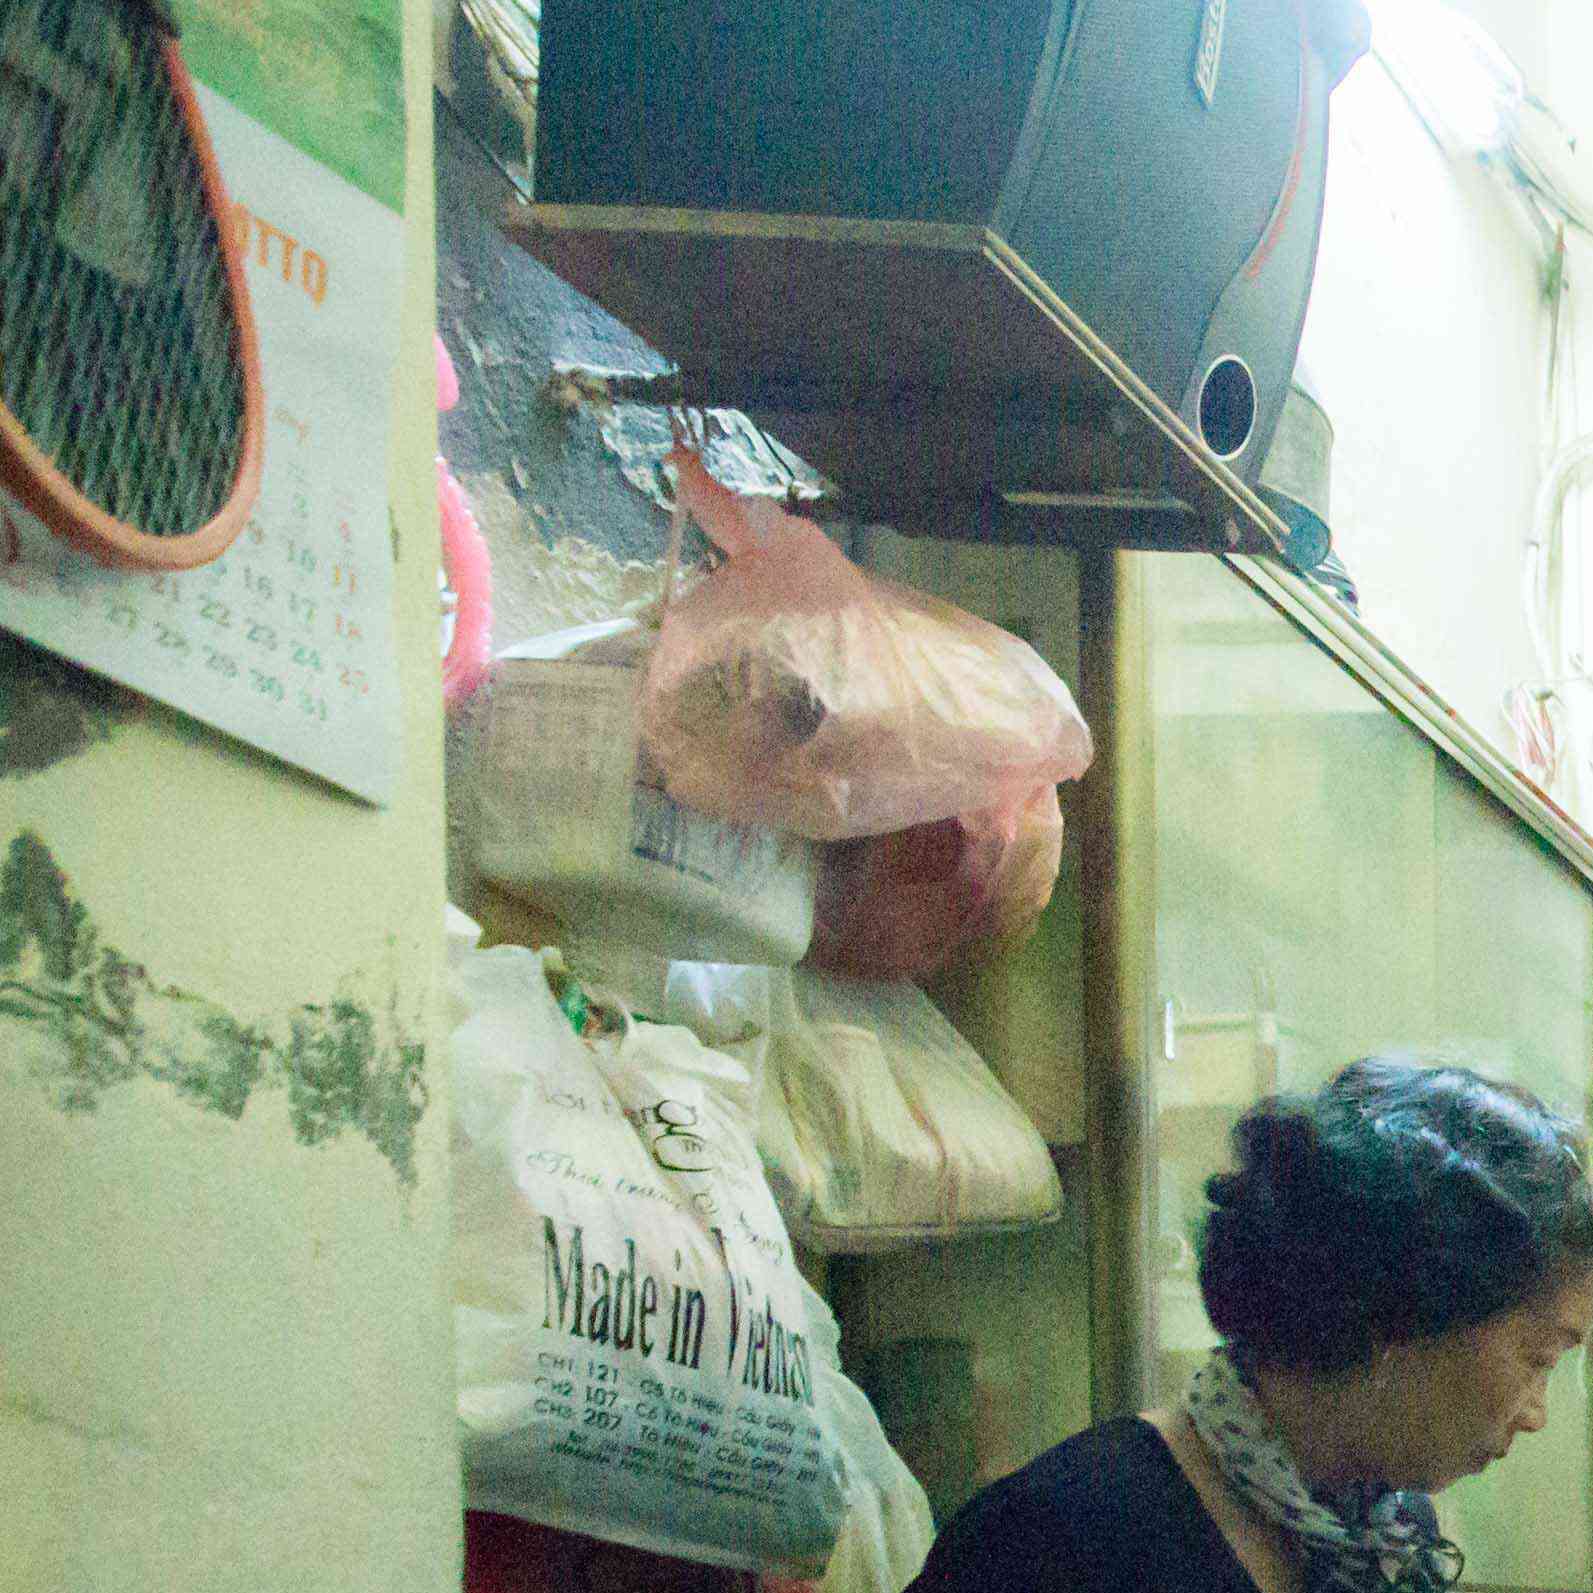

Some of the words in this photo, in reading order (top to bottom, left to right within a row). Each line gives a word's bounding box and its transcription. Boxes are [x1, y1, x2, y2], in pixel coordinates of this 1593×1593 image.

[542, 1214, 657, 1358] Made
[664, 1246, 706, 1370] in
[708, 1226, 815, 1408] Vietna
[583, 1406, 623, 1432] 207
